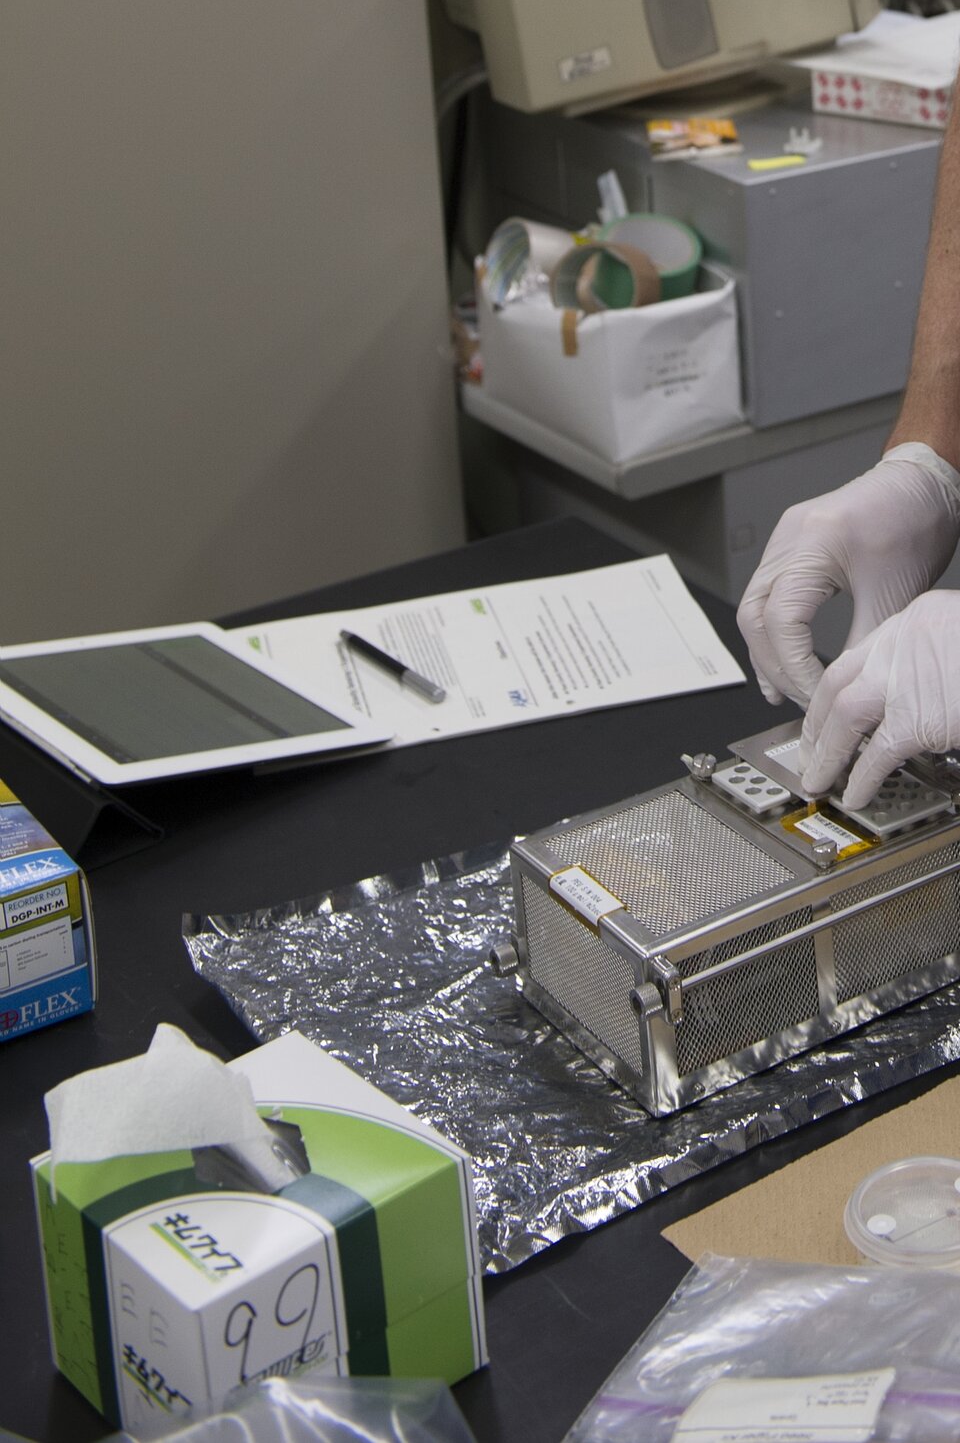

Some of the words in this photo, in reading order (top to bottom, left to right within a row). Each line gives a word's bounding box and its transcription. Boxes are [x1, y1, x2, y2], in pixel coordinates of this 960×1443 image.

[8, 893, 45, 911] REORDER
[46, 886, 64, 899] NO.
[11, 898, 65, 924] DGP-INT-M
[12, 1021, 34, 1033] NAME
